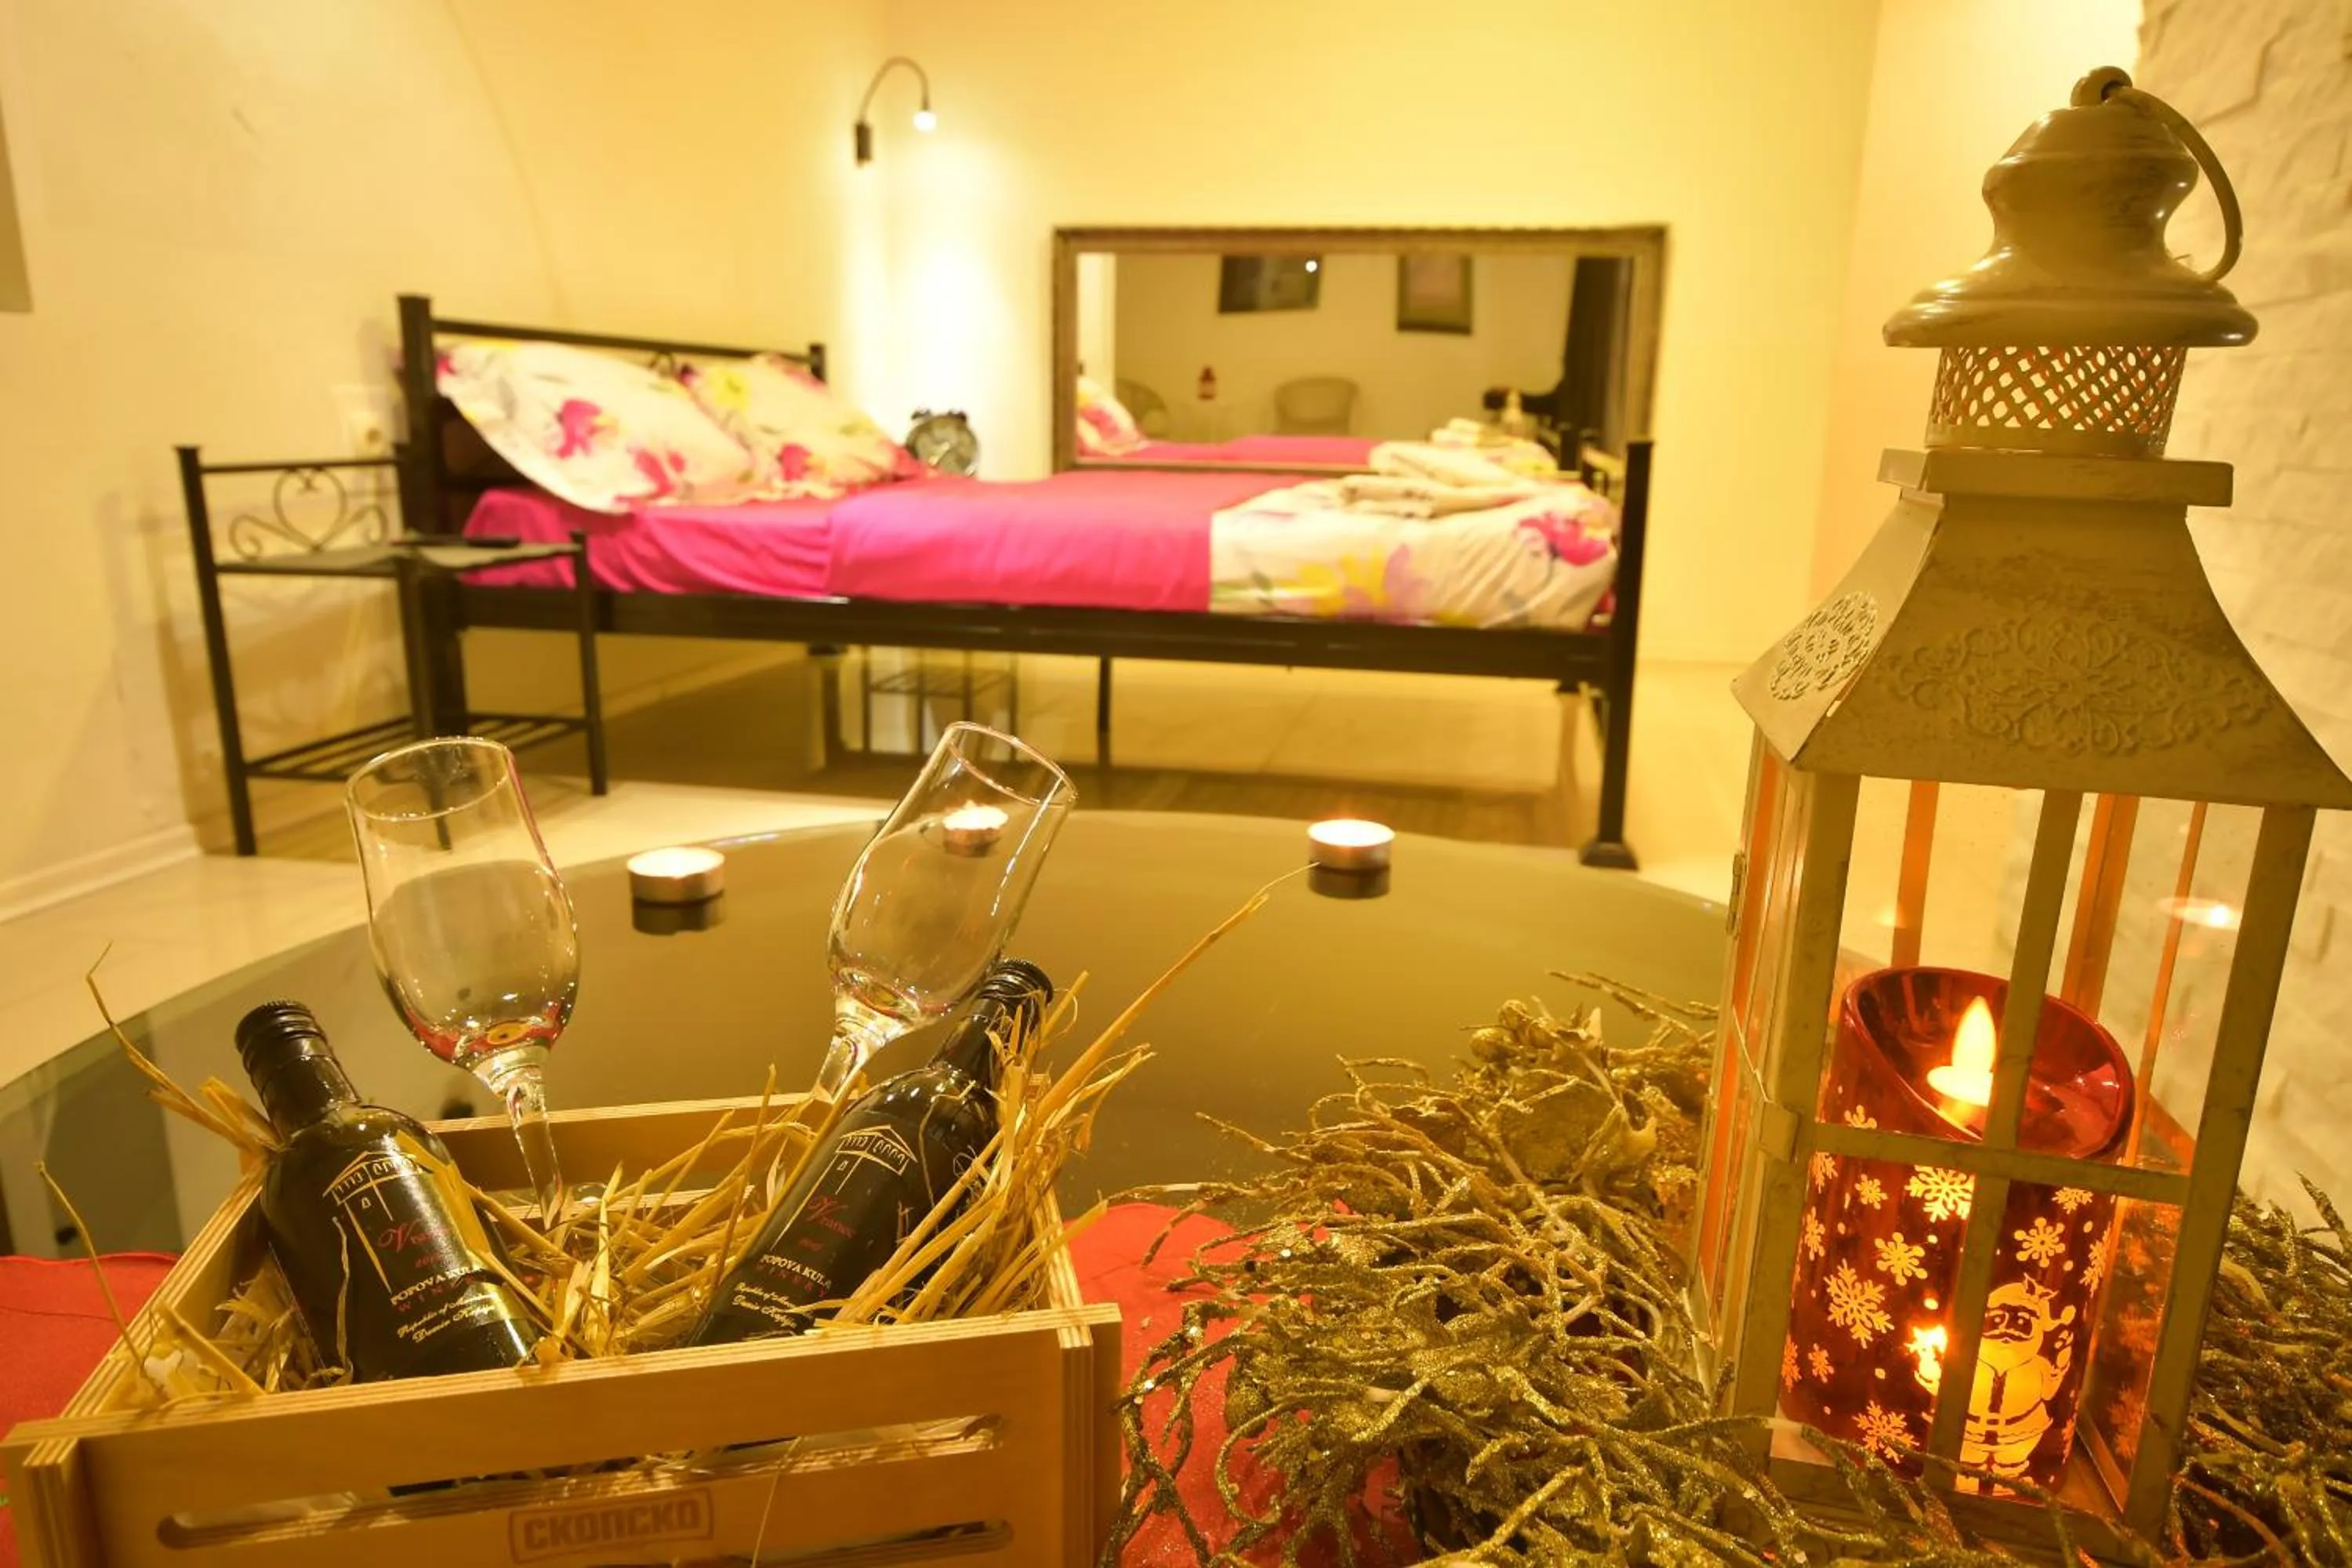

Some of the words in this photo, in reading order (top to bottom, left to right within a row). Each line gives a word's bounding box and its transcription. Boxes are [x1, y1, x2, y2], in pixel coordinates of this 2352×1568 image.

[390, 1272, 446, 1305] POPOVA
[801, 1266, 833, 1290] KULA
[523, 1499, 701, 1549] СКОПСКО
